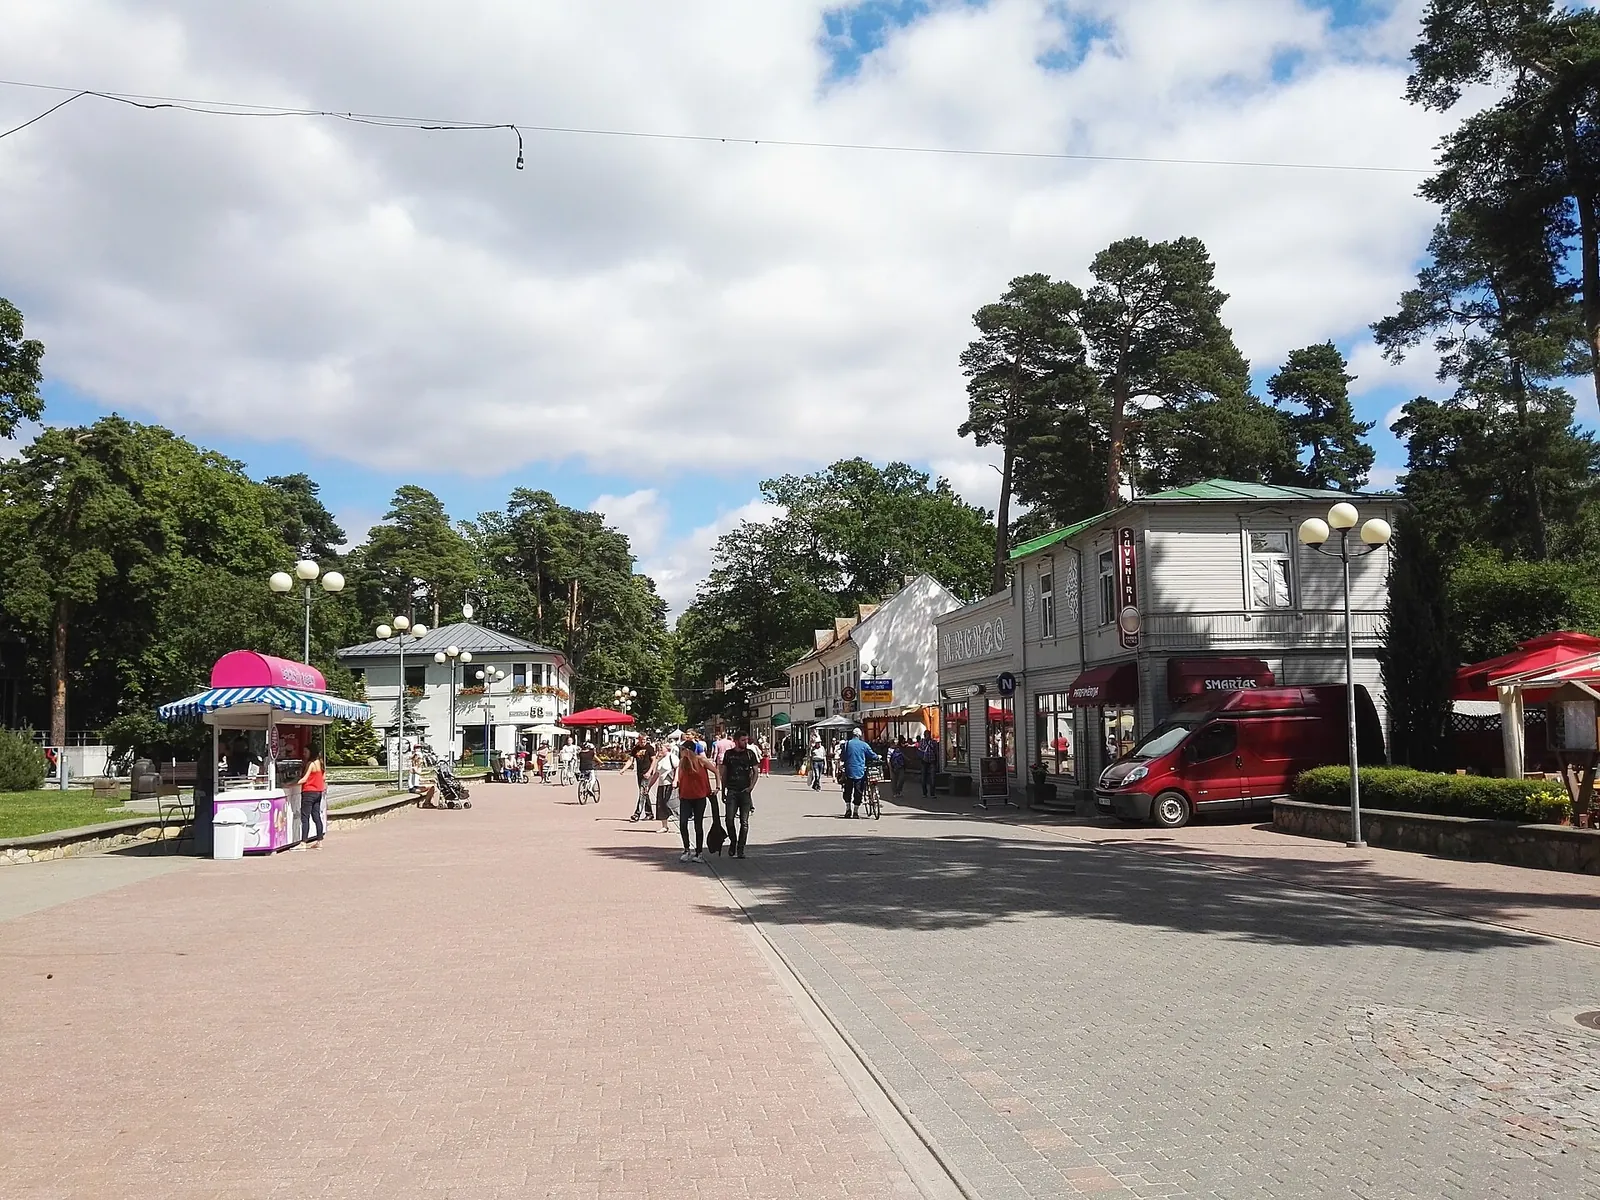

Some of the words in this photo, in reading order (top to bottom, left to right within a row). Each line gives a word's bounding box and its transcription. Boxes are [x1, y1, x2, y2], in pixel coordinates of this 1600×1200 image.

[1124, 530, 1133, 603] SUVENIRI
[1002, 678, 1013, 690] N
[1205, 676, 1257, 690] SMARŽAS
